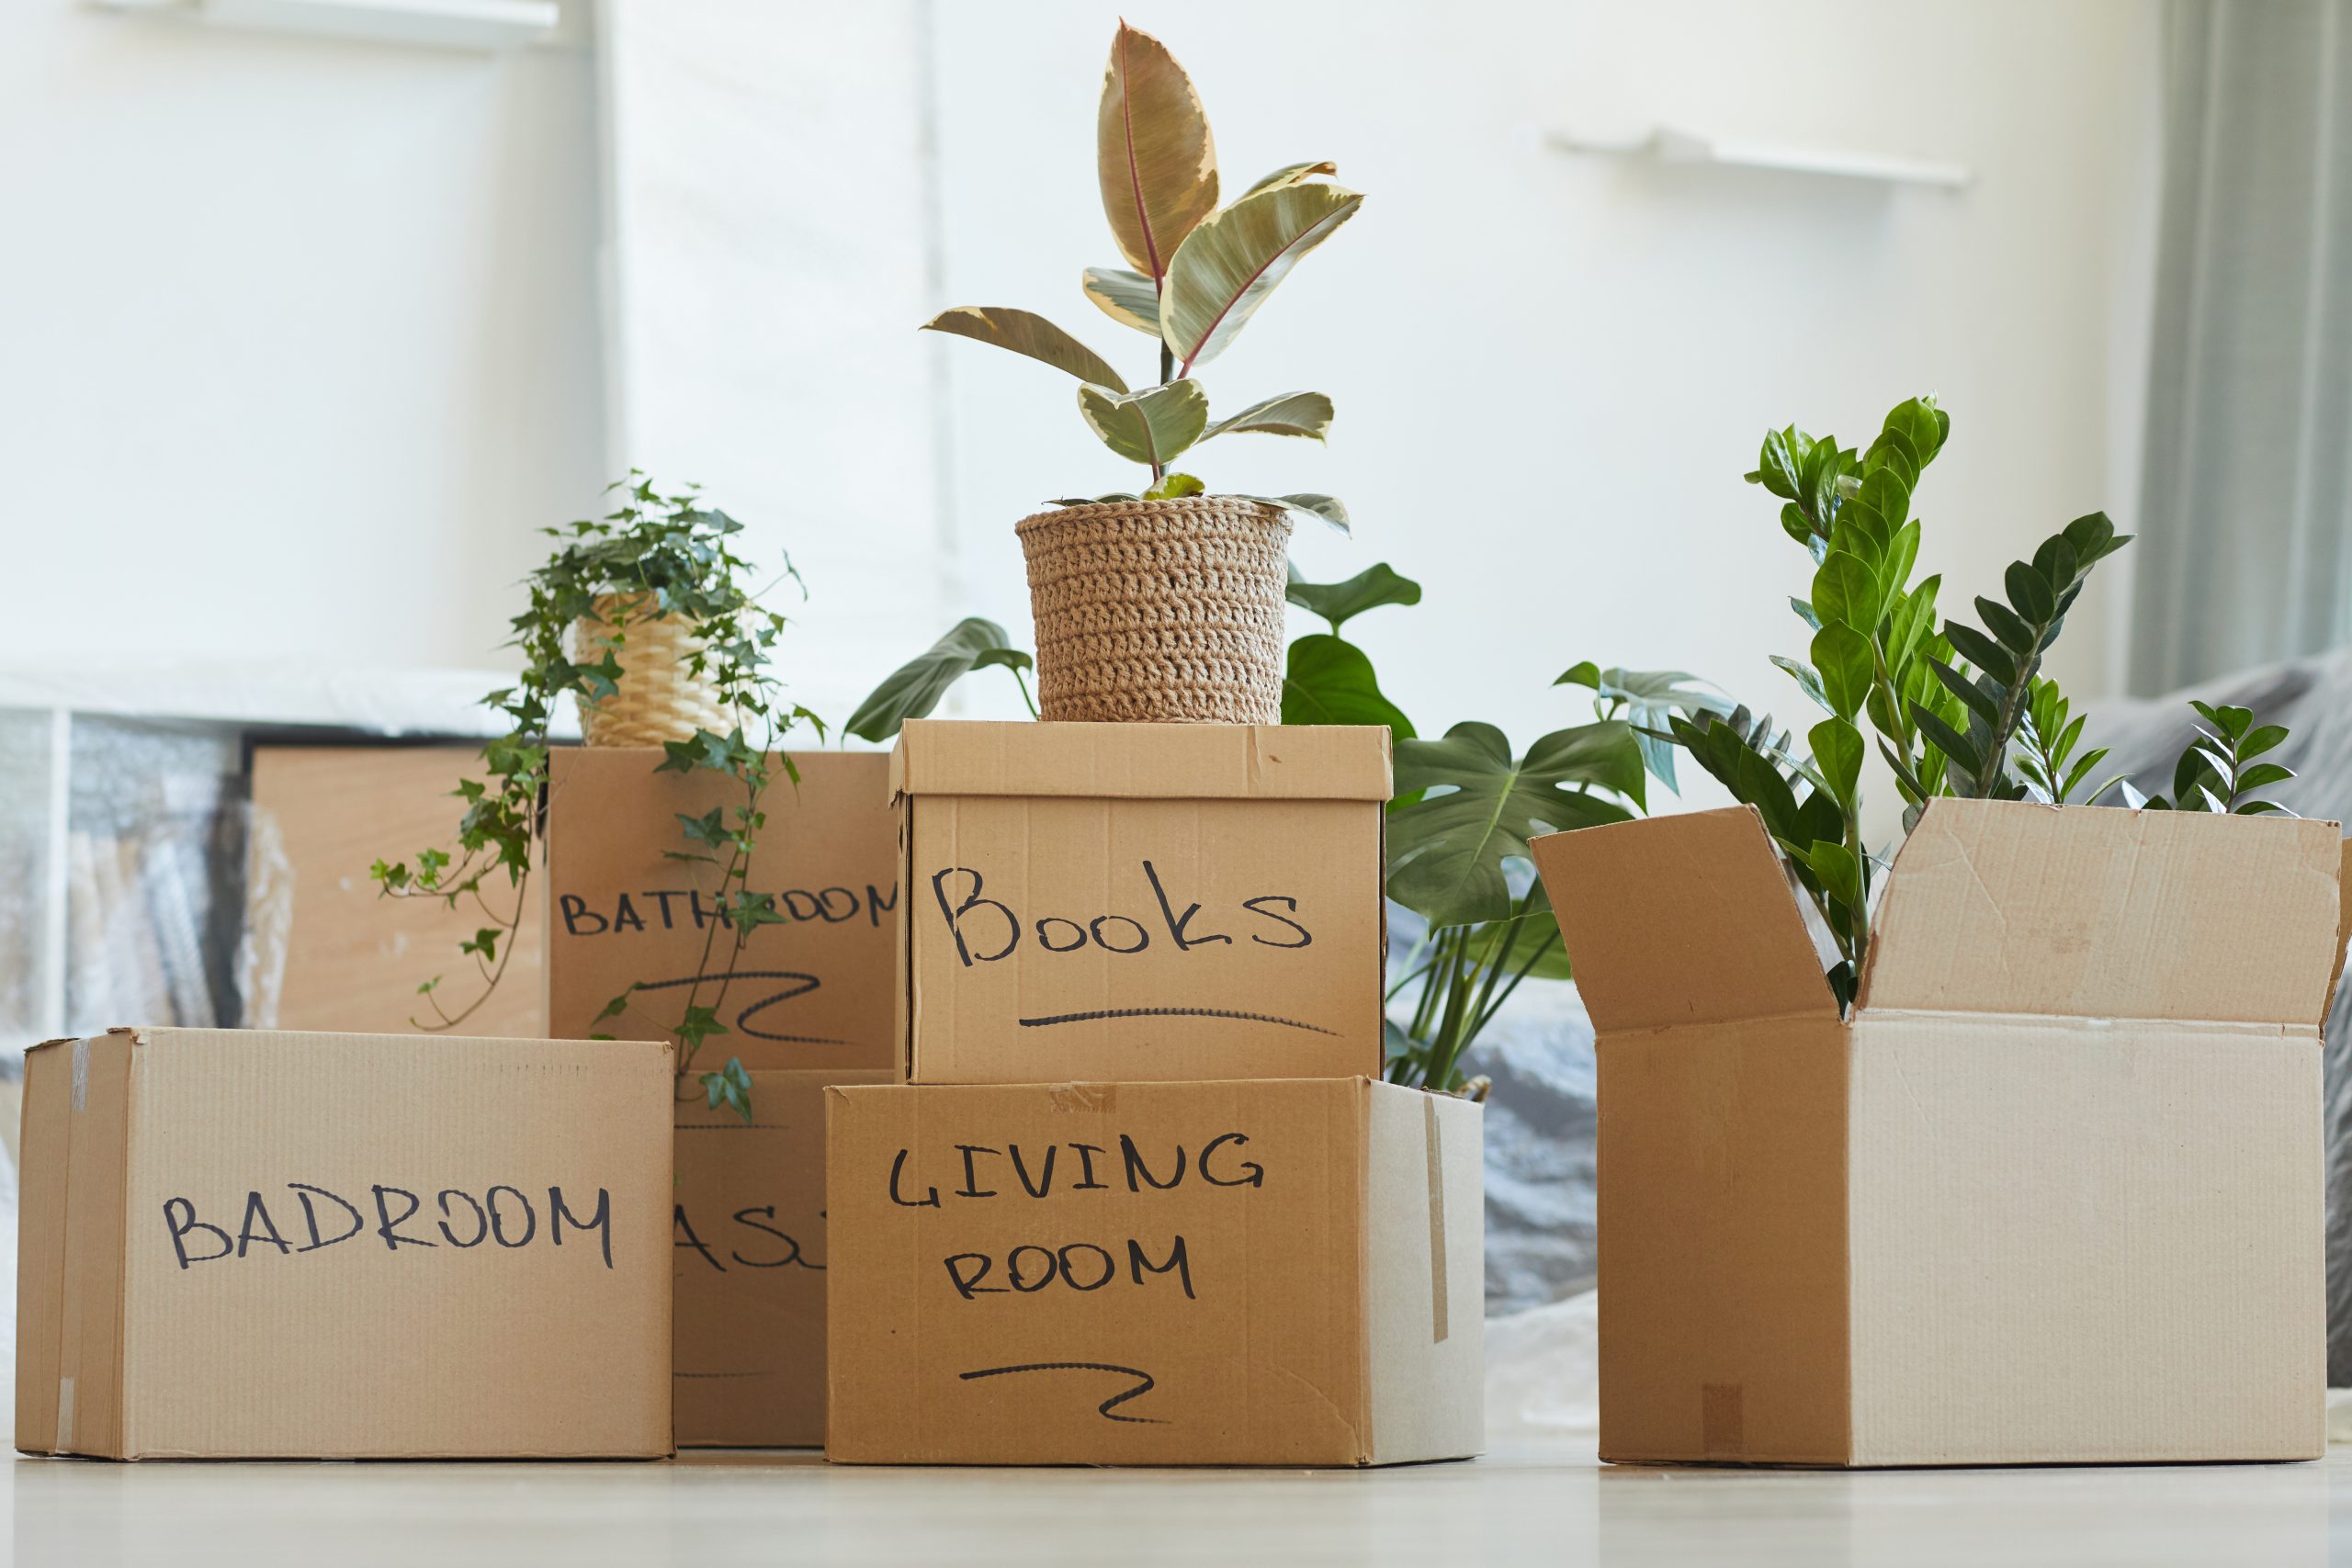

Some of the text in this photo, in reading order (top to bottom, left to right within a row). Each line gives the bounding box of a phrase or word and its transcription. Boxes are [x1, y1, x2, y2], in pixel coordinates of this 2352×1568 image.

[560, 881, 898, 936] BATHOOM
[932, 860, 1312, 967] Books
[888, 1133, 1264, 1209] LIVING
[163, 1182, 614, 1270] BADROOM
[944, 1235, 1196, 1300] ROOM
